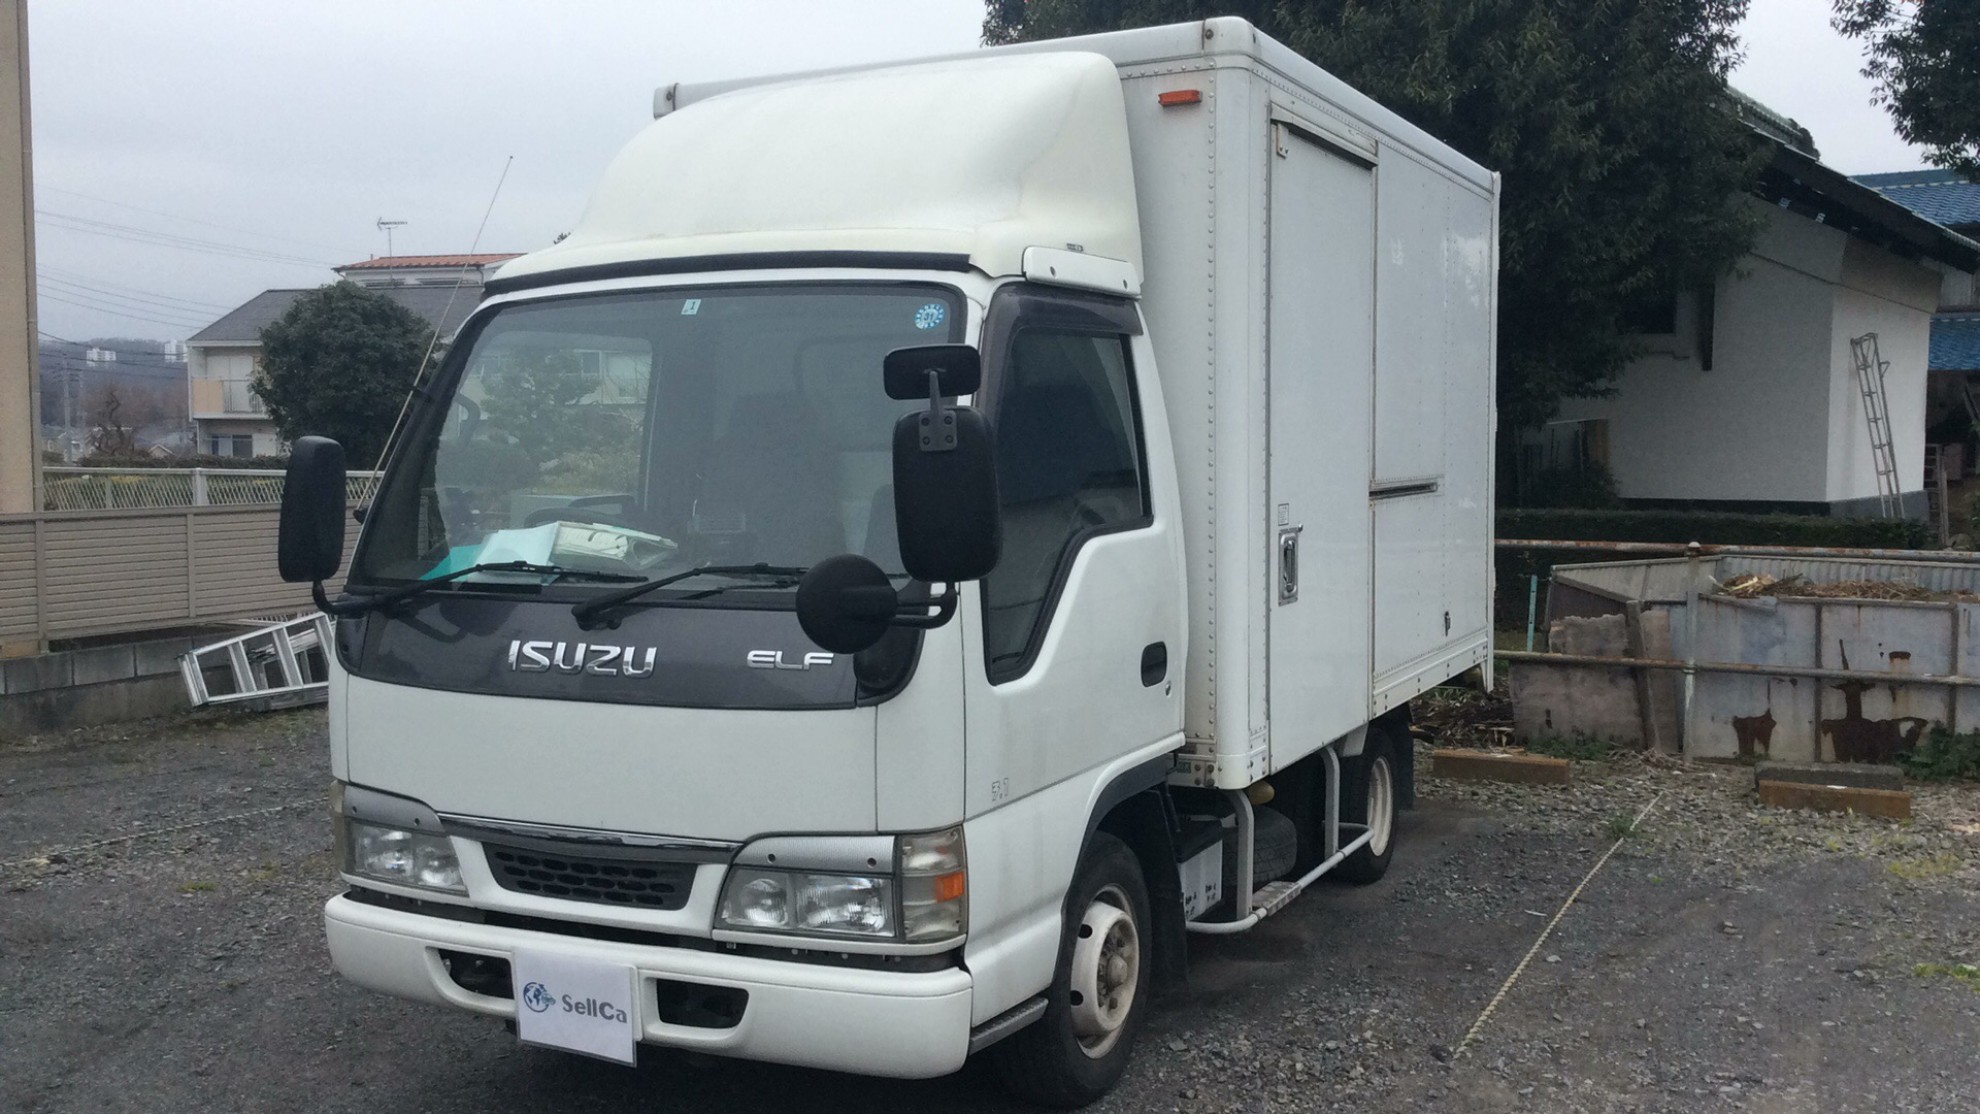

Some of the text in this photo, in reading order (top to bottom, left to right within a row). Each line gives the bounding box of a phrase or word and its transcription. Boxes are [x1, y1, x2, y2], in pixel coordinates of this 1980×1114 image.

[507, 640, 658, 678] ISUZU
[746, 649, 835, 671] ELF
[561, 994, 628, 1024] SellCa
